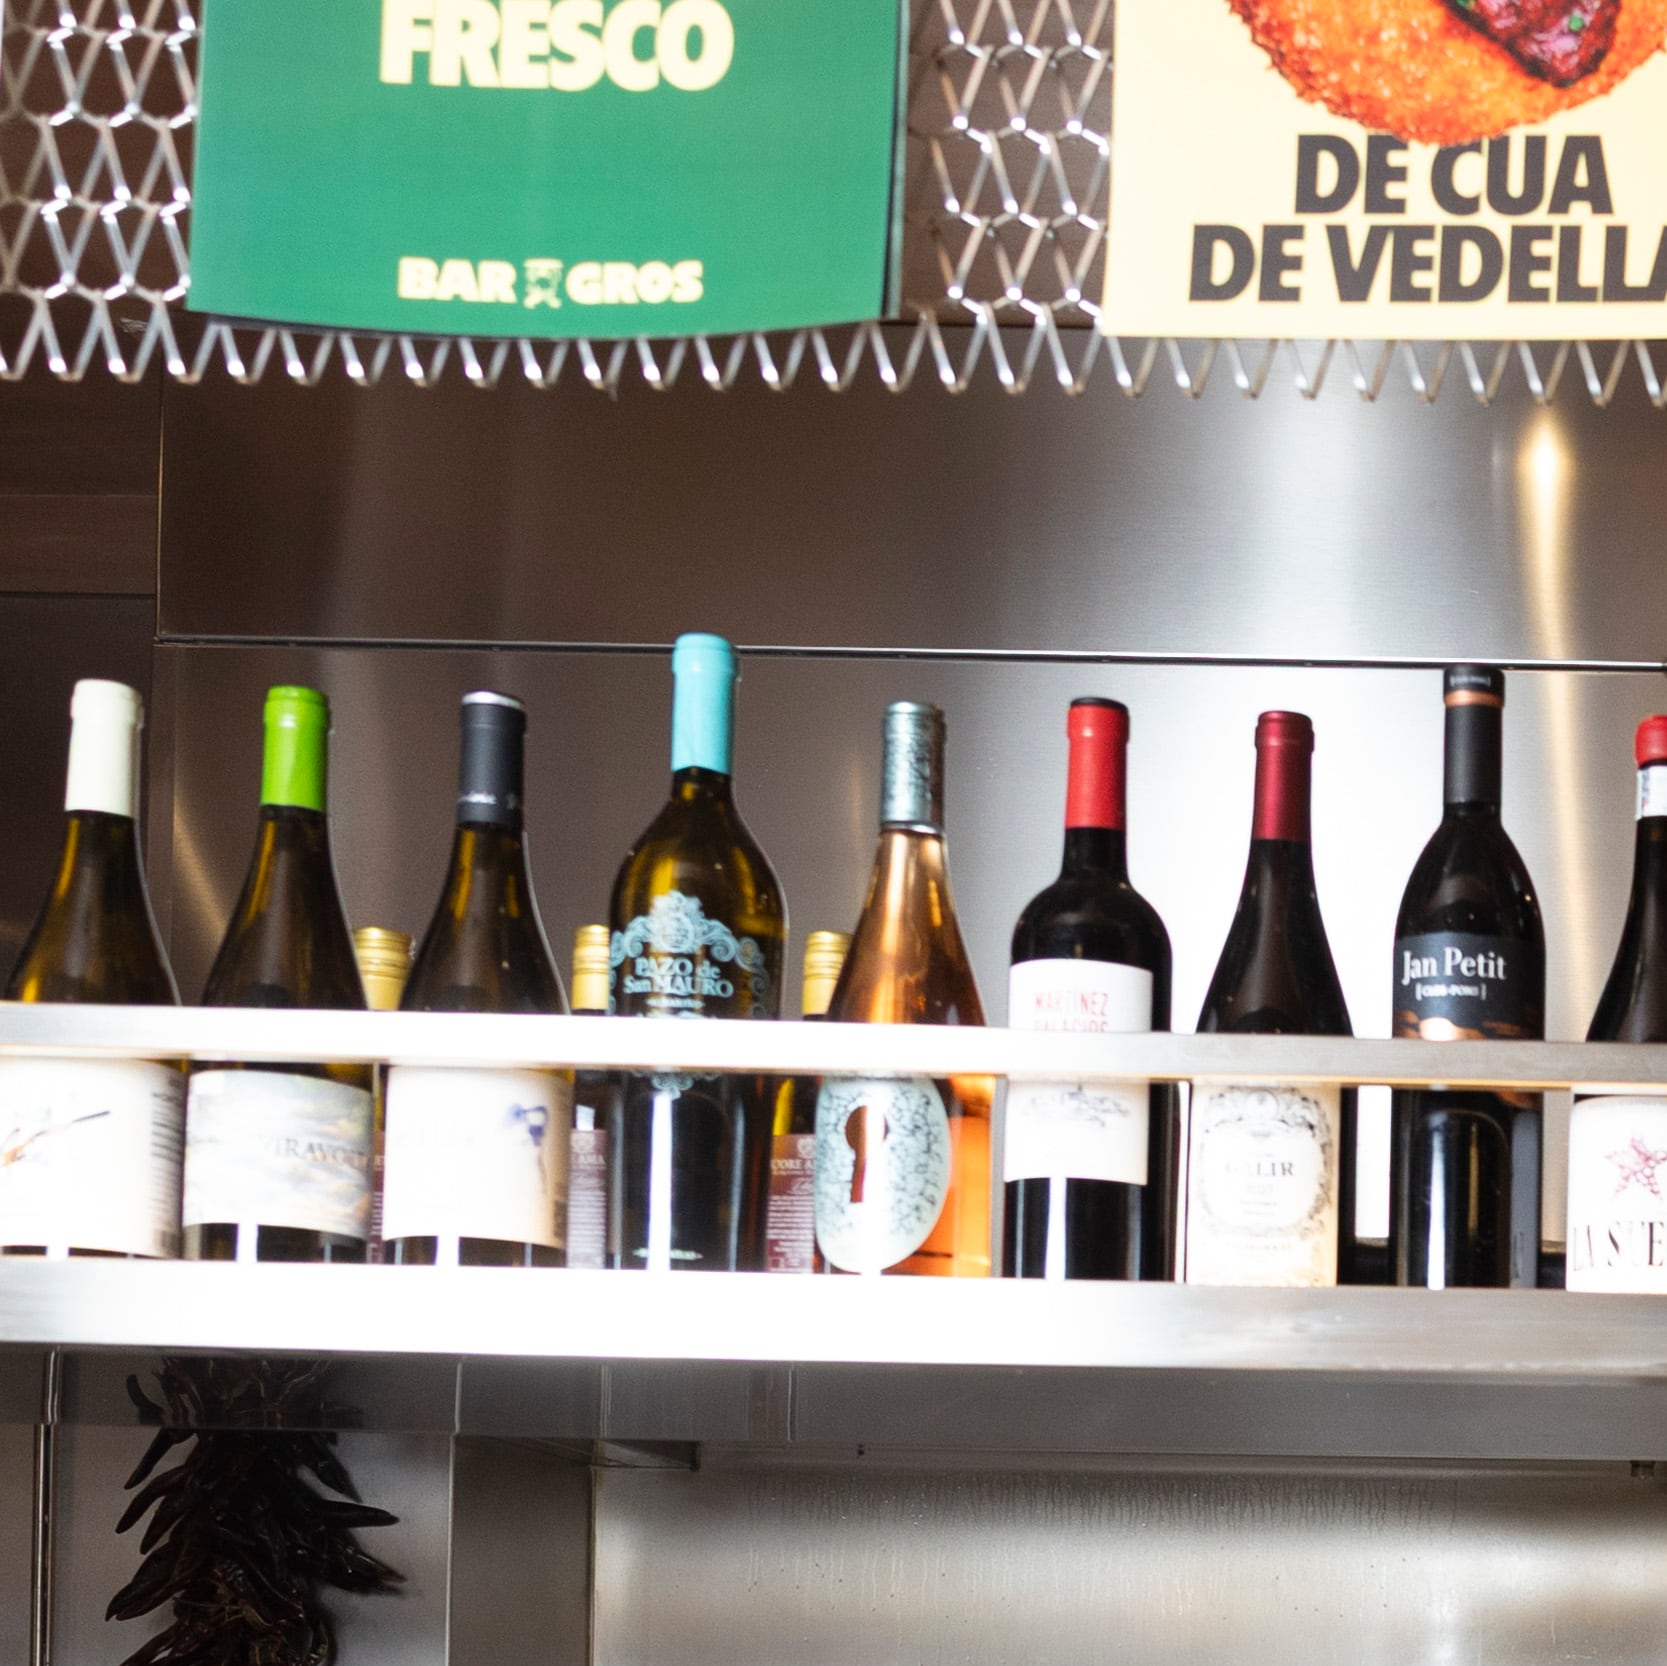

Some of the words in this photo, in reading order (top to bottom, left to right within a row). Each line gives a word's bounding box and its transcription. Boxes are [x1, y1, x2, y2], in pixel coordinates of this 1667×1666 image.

[380, 0, 734, 91] FRESCO
[1294, 133, 1409, 215] DE
[1430, 133, 1614, 216] CUA
[398, 256, 517, 306] BAR
[565, 260, 704, 305] GROS
[1188, 224, 1305, 303] DE
[635, 957, 693, 978] PAZO
[652, 975, 734, 998] MAURO
[1402, 950, 1438, 985] Jan
[1444, 946, 1507, 981] Petit
